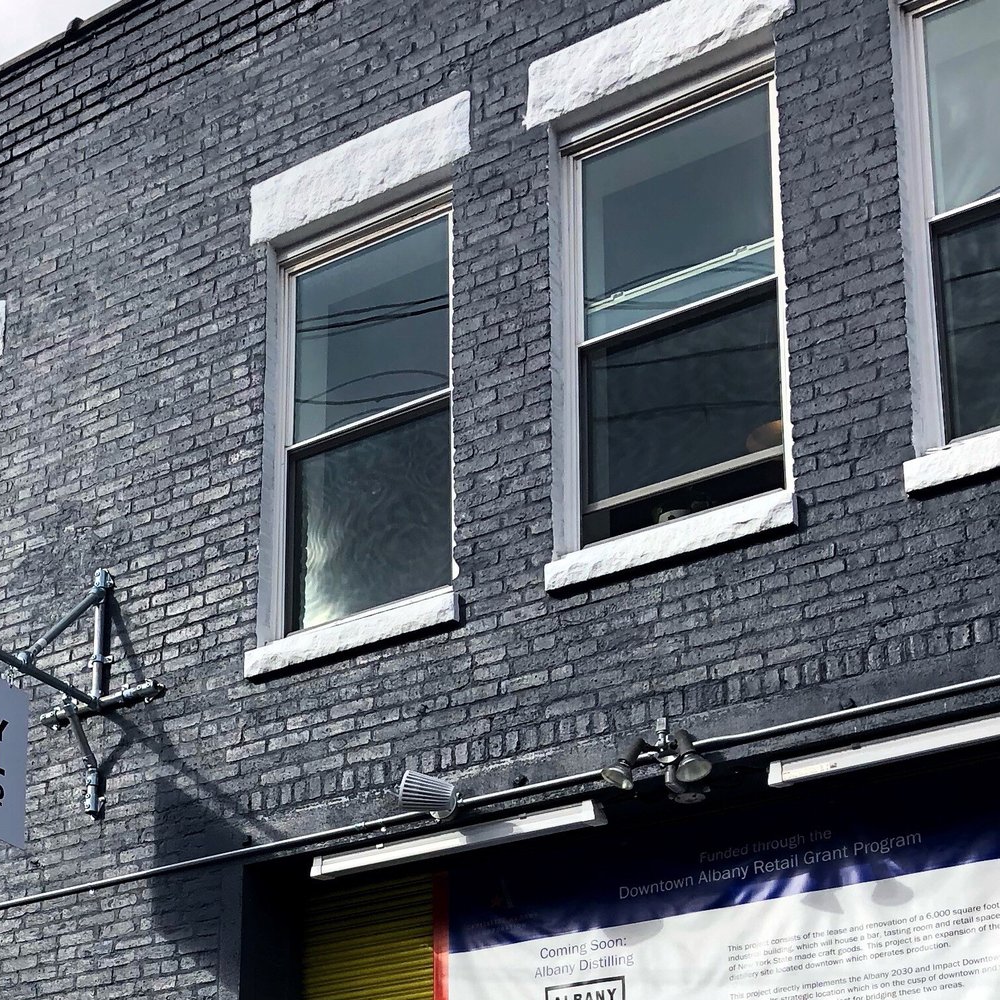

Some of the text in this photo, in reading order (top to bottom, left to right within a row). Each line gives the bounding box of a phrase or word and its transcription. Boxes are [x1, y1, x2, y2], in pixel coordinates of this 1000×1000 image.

[699, 829, 832, 863] Funded through the
[619, 833, 922, 899] Downtown Albany Retail Grant Program
[744, 938, 769, 950] prot
[812, 930, 824, 938] the
[826, 927, 847, 935] lease
[849, 923, 863, 931] and
[865, 917, 907, 929] renovation
[909, 914, 918, 922] of
[952, 906, 980, 916] square
[983, 901, 1000, 910] foot
[796, 940, 818, 950] which
[820, 938, 832, 947] will
[834, 936, 858, 944] house
[883, 927, 911, 936] tasting
[912, 923, 934, 931] room
[935, 919, 950, 928] and
[952, 915, 973, 925] retail
[540, 937, 627, 959] Coming Soon:
[728, 963, 736, 971] of
[794, 952, 816, 961] made
[818, 948, 835, 957] craft
[867, 941, 882, 949] This
[884, 936, 912, 948] project
[934, 927, 976, 939] expansion
[978, 924, 988, 932] of
[760, 968, 773, 976] site
[805, 958, 843, 969] downtown
[845, 953, 867, 963] which
[869, 949, 904, 960] operates
[535, 953, 635, 978] Albany Distilling
[729, 992, 744, 1000] This
[746, 988, 771, 999] project
[773, 984, 800, 994] directly
[802, 977, 847, 990] implements
[863, 972, 889, 980] Albany
[891, 967, 912, 976] 2030
[914, 964, 930, 973] and
[932, 960, 960, 970] Impact
[815, 988, 846, 998] location
[847, 983, 869, 993] which
[892, 978, 905, 986] the
[907, 976, 926, 984] cusp
[928, 973, 936, 981] of
[938, 968, 979, 979] downtown
[981, 964, 997, 973] and
[865, 990, 897, 1000] bridging
[898, 987, 920, 995] these
[939, 982, 964, 990] areas.
